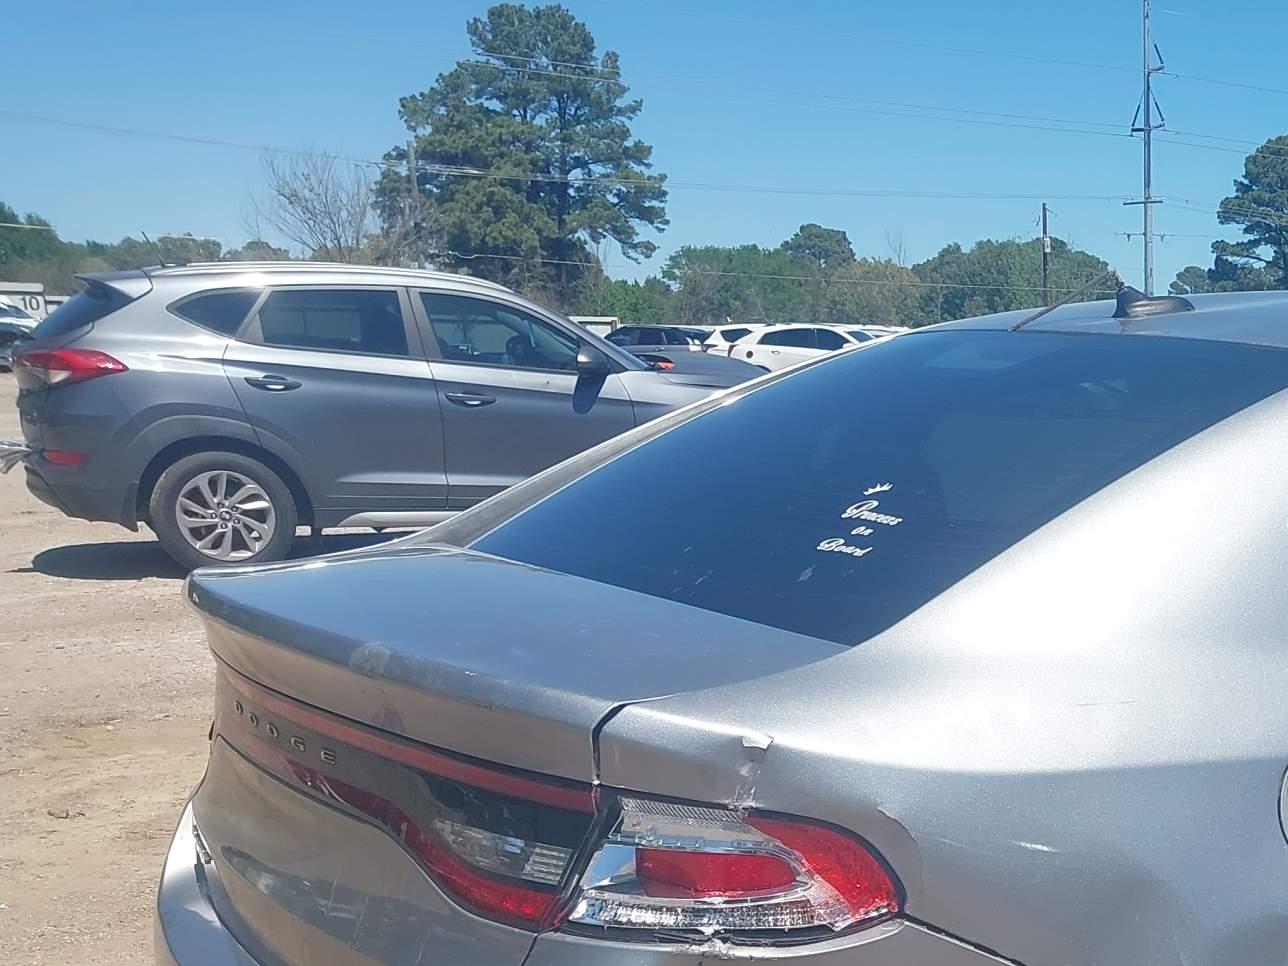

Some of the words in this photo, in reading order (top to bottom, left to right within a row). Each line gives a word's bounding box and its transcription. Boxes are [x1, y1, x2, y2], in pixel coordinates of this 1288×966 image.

[20, 295, 40, 311] 10
[841, 500, 903, 526] Princess
[816, 538, 873, 557] Board
[234, 700, 336, 764] DODGE
